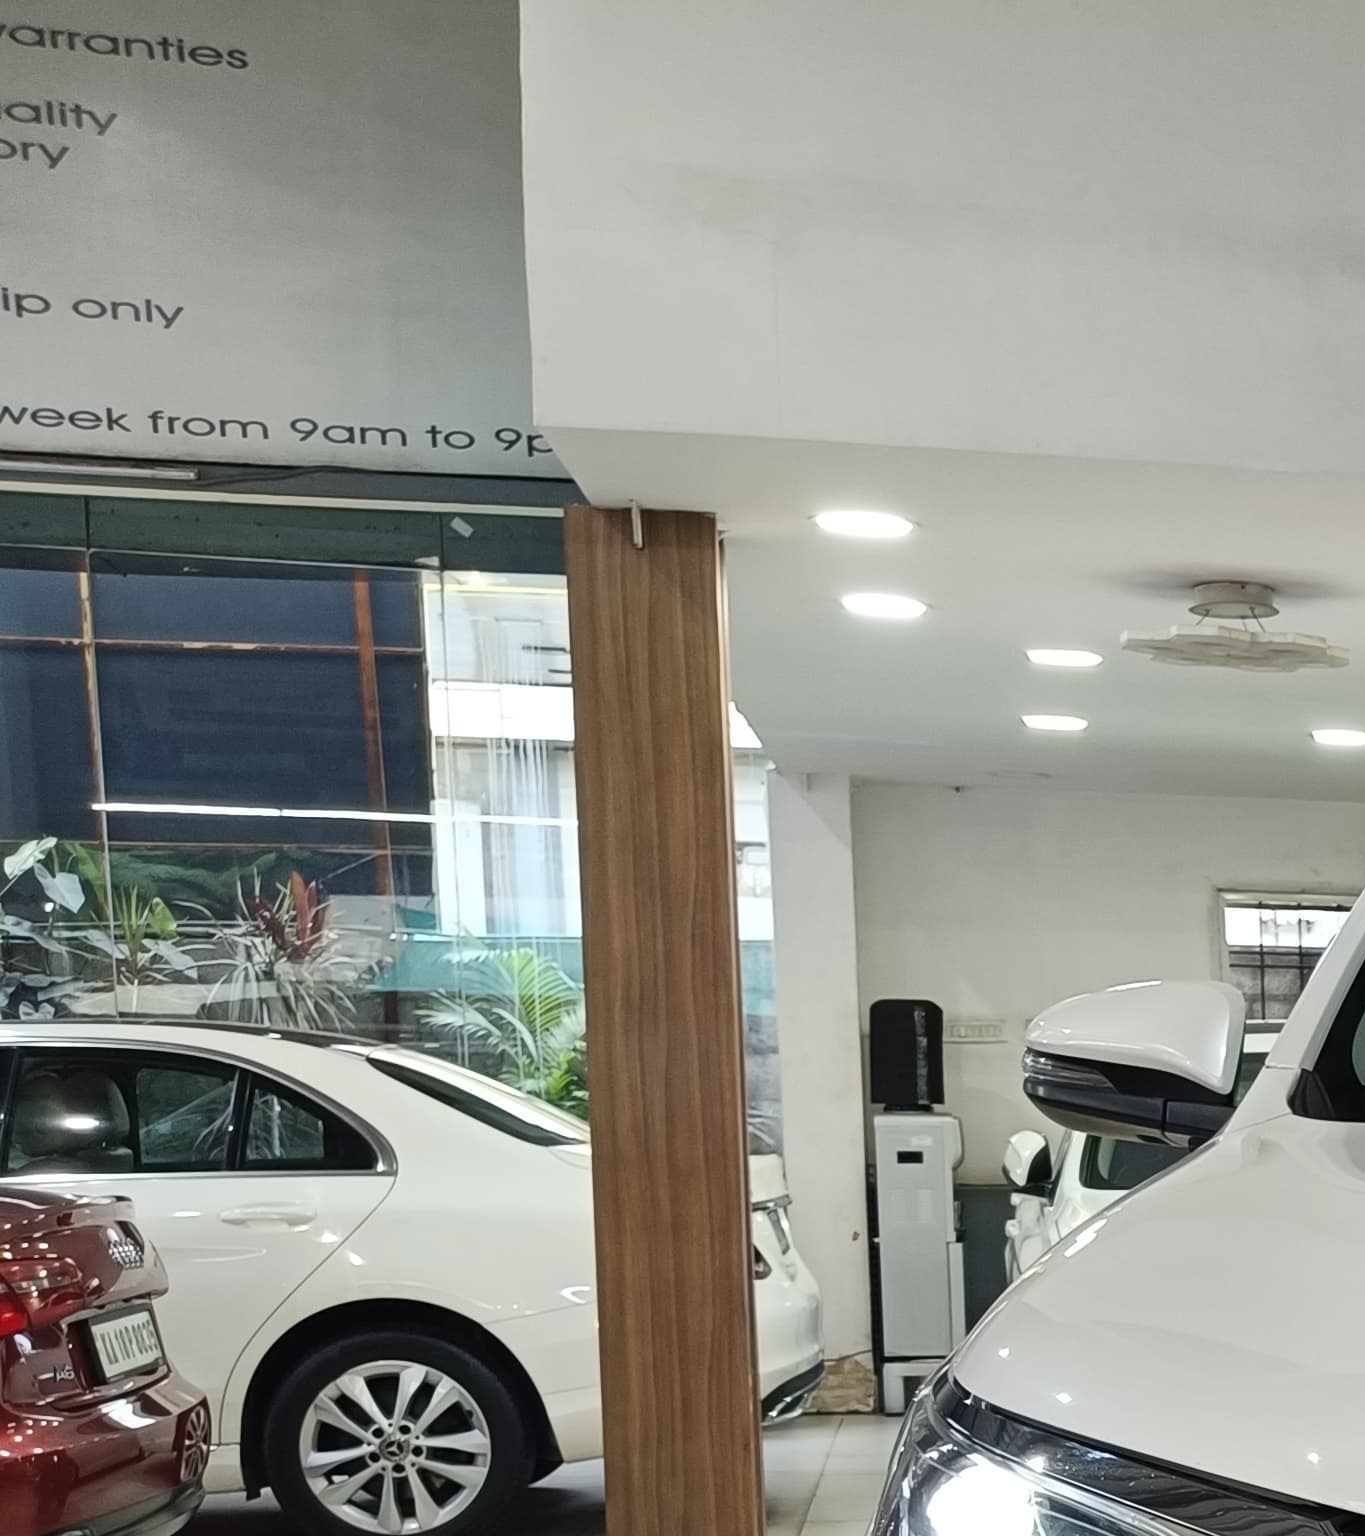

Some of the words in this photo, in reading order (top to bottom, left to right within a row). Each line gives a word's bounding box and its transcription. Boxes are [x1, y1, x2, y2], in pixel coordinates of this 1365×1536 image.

[0, 23, 249, 69] arranties
[0, 100, 118, 136] ality
[72, 299, 184, 329] only
[147, 410, 269, 439] from
[290, 418, 407, 446] 9am
[424, 425, 476, 449] to
